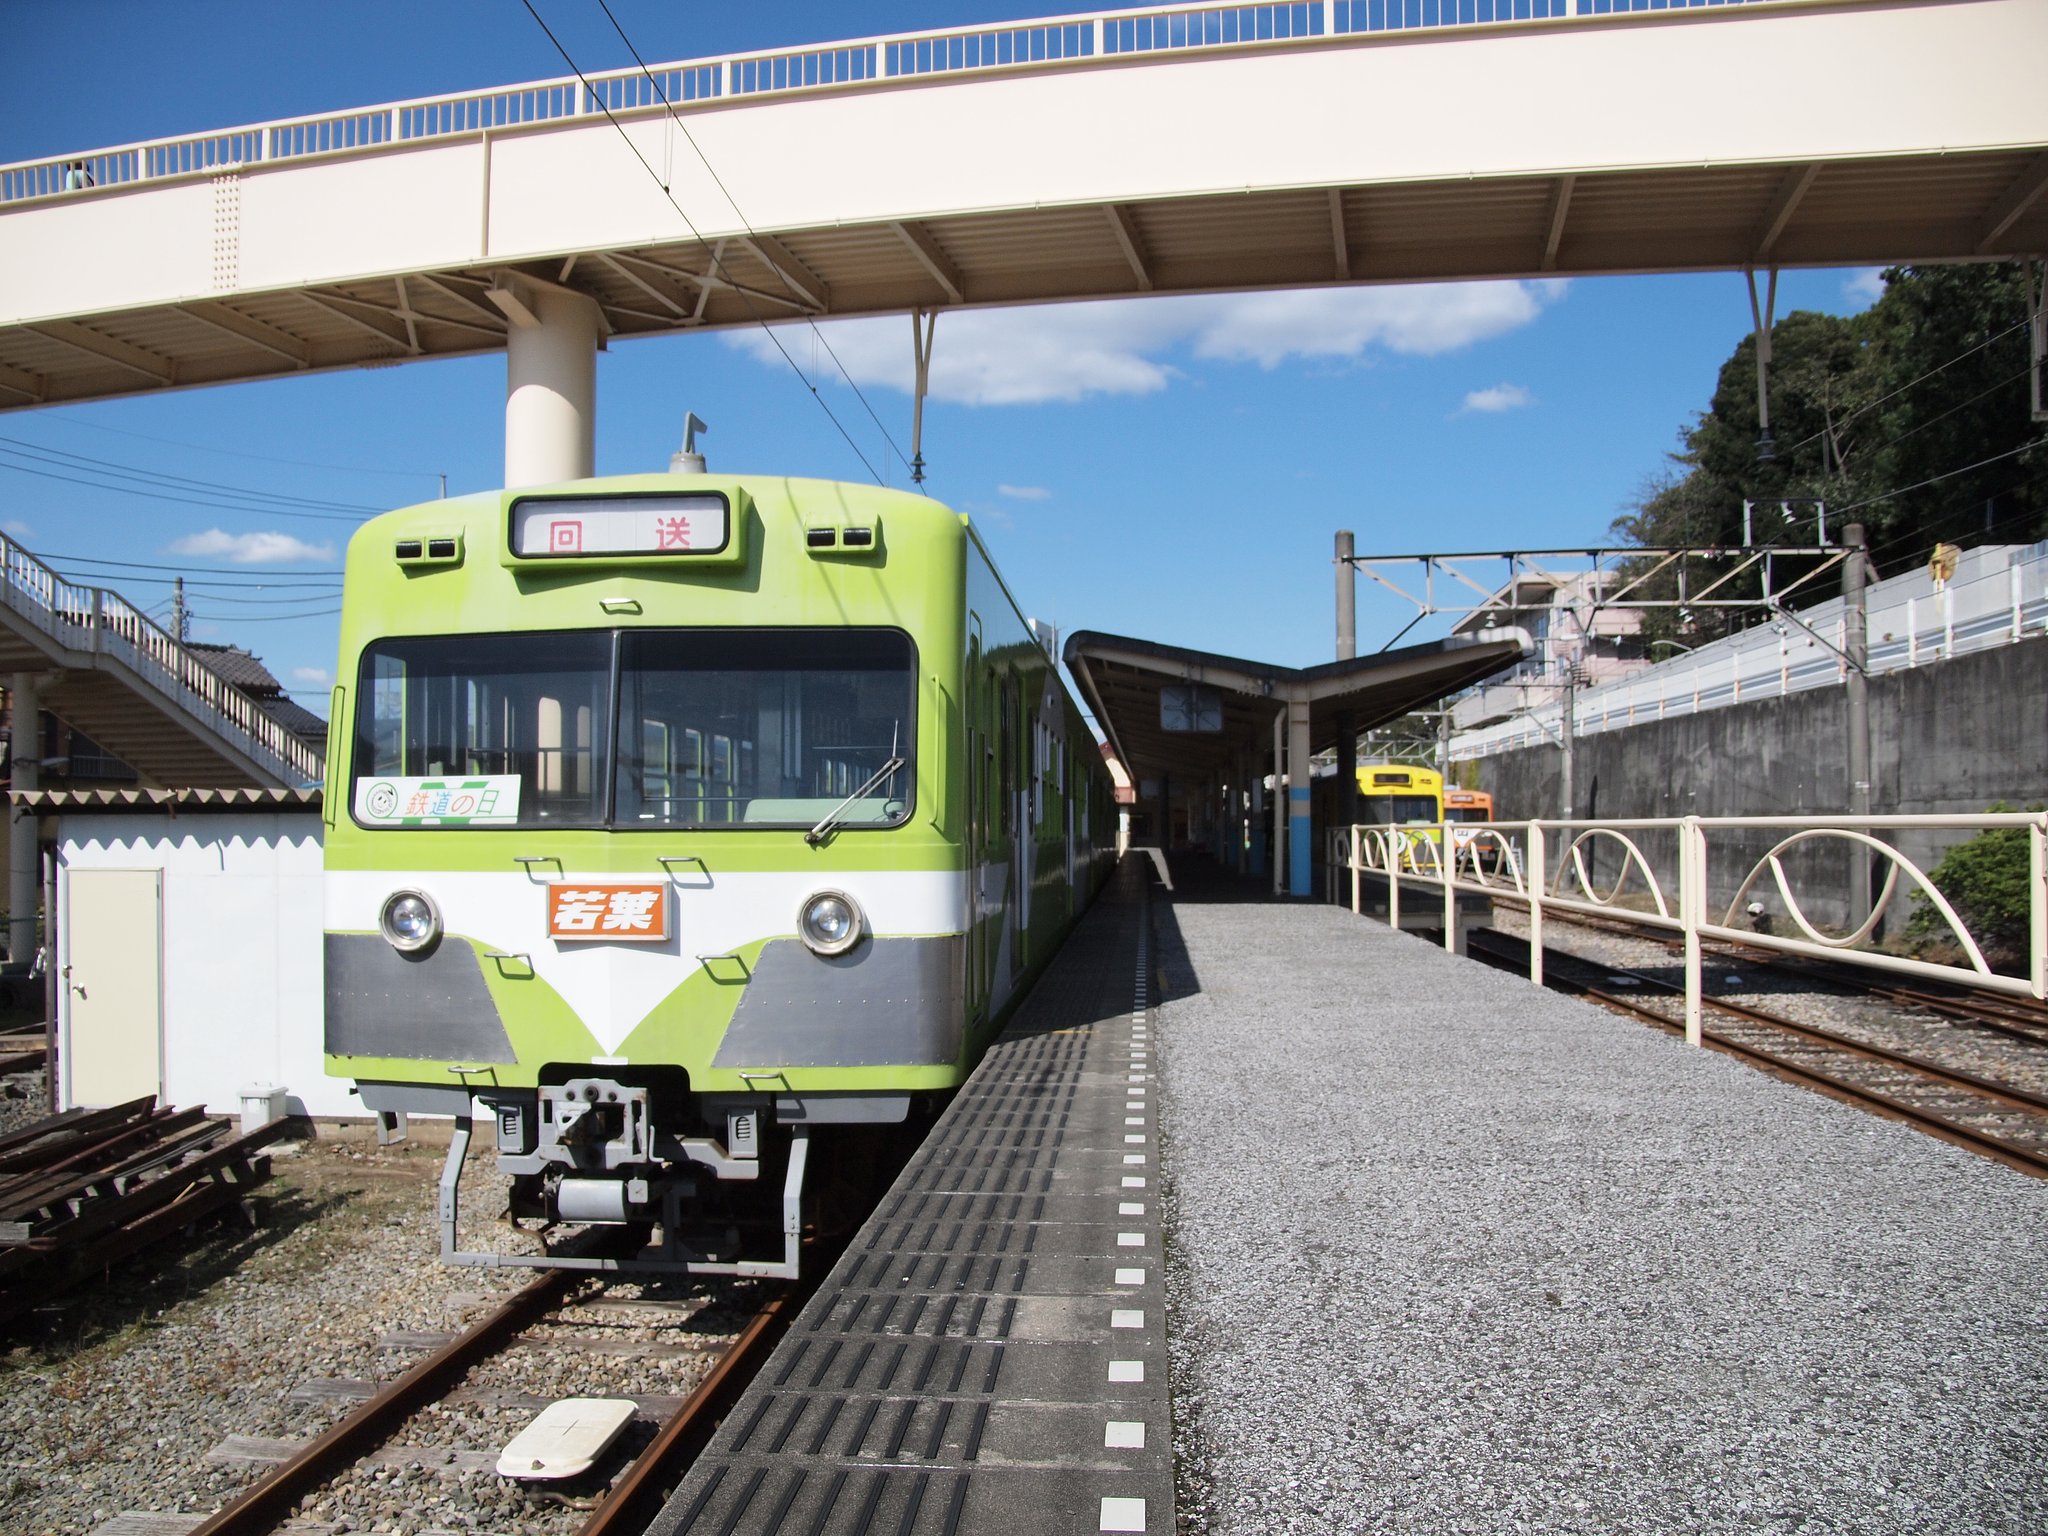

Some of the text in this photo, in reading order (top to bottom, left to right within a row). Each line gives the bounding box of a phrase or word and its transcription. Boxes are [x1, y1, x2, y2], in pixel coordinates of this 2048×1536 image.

[550, 517, 691, 553] 回送
[405, 790, 500, 816] 鉄道の日
[553, 890, 660, 930] 若葉
